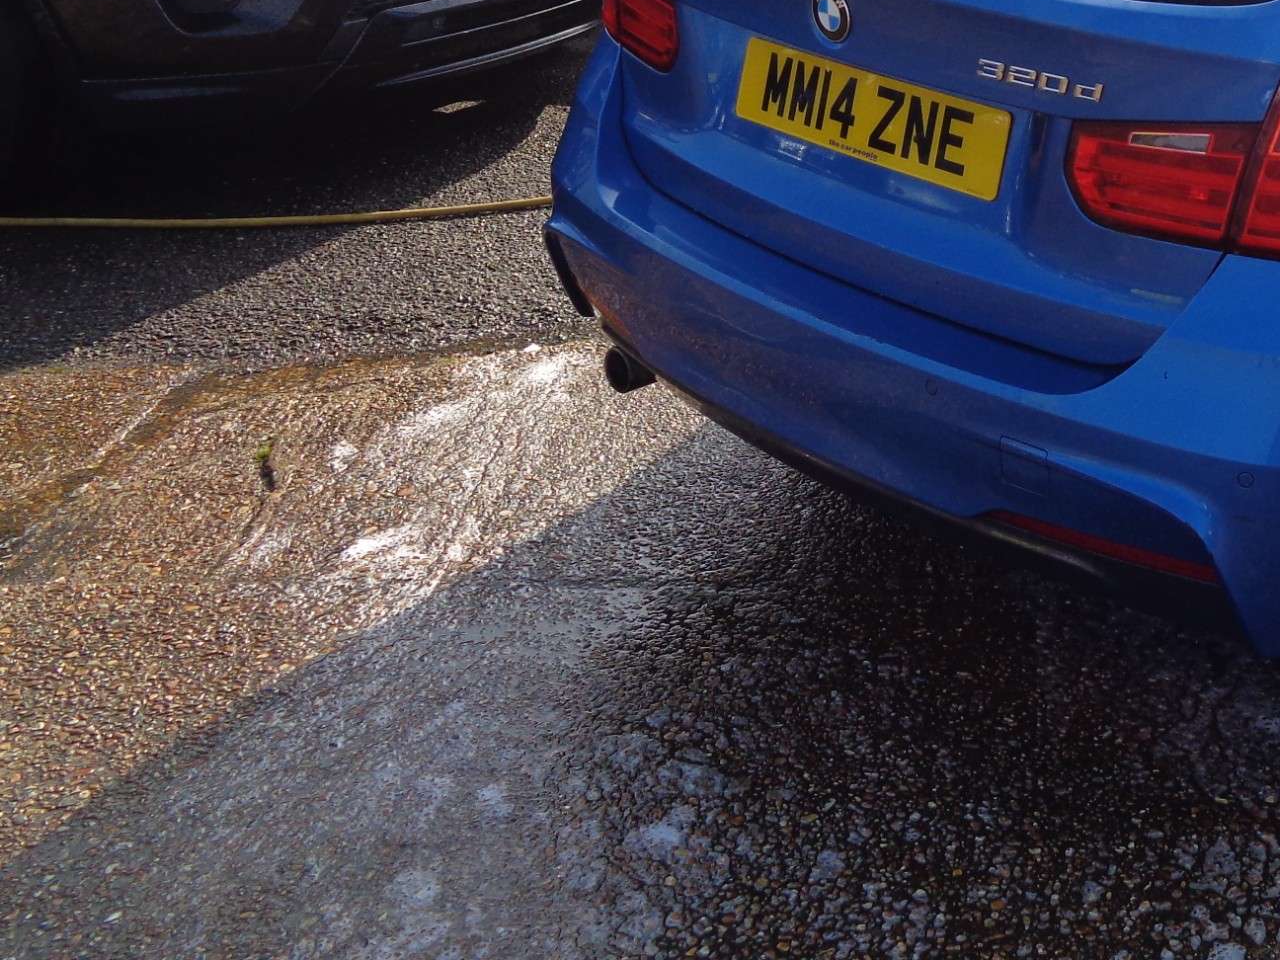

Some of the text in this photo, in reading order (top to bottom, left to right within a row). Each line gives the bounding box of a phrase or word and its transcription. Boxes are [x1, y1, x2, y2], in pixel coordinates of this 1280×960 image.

[761, 52, 975, 177] MM14 ZNE
[976, 57, 1104, 102] 320d
